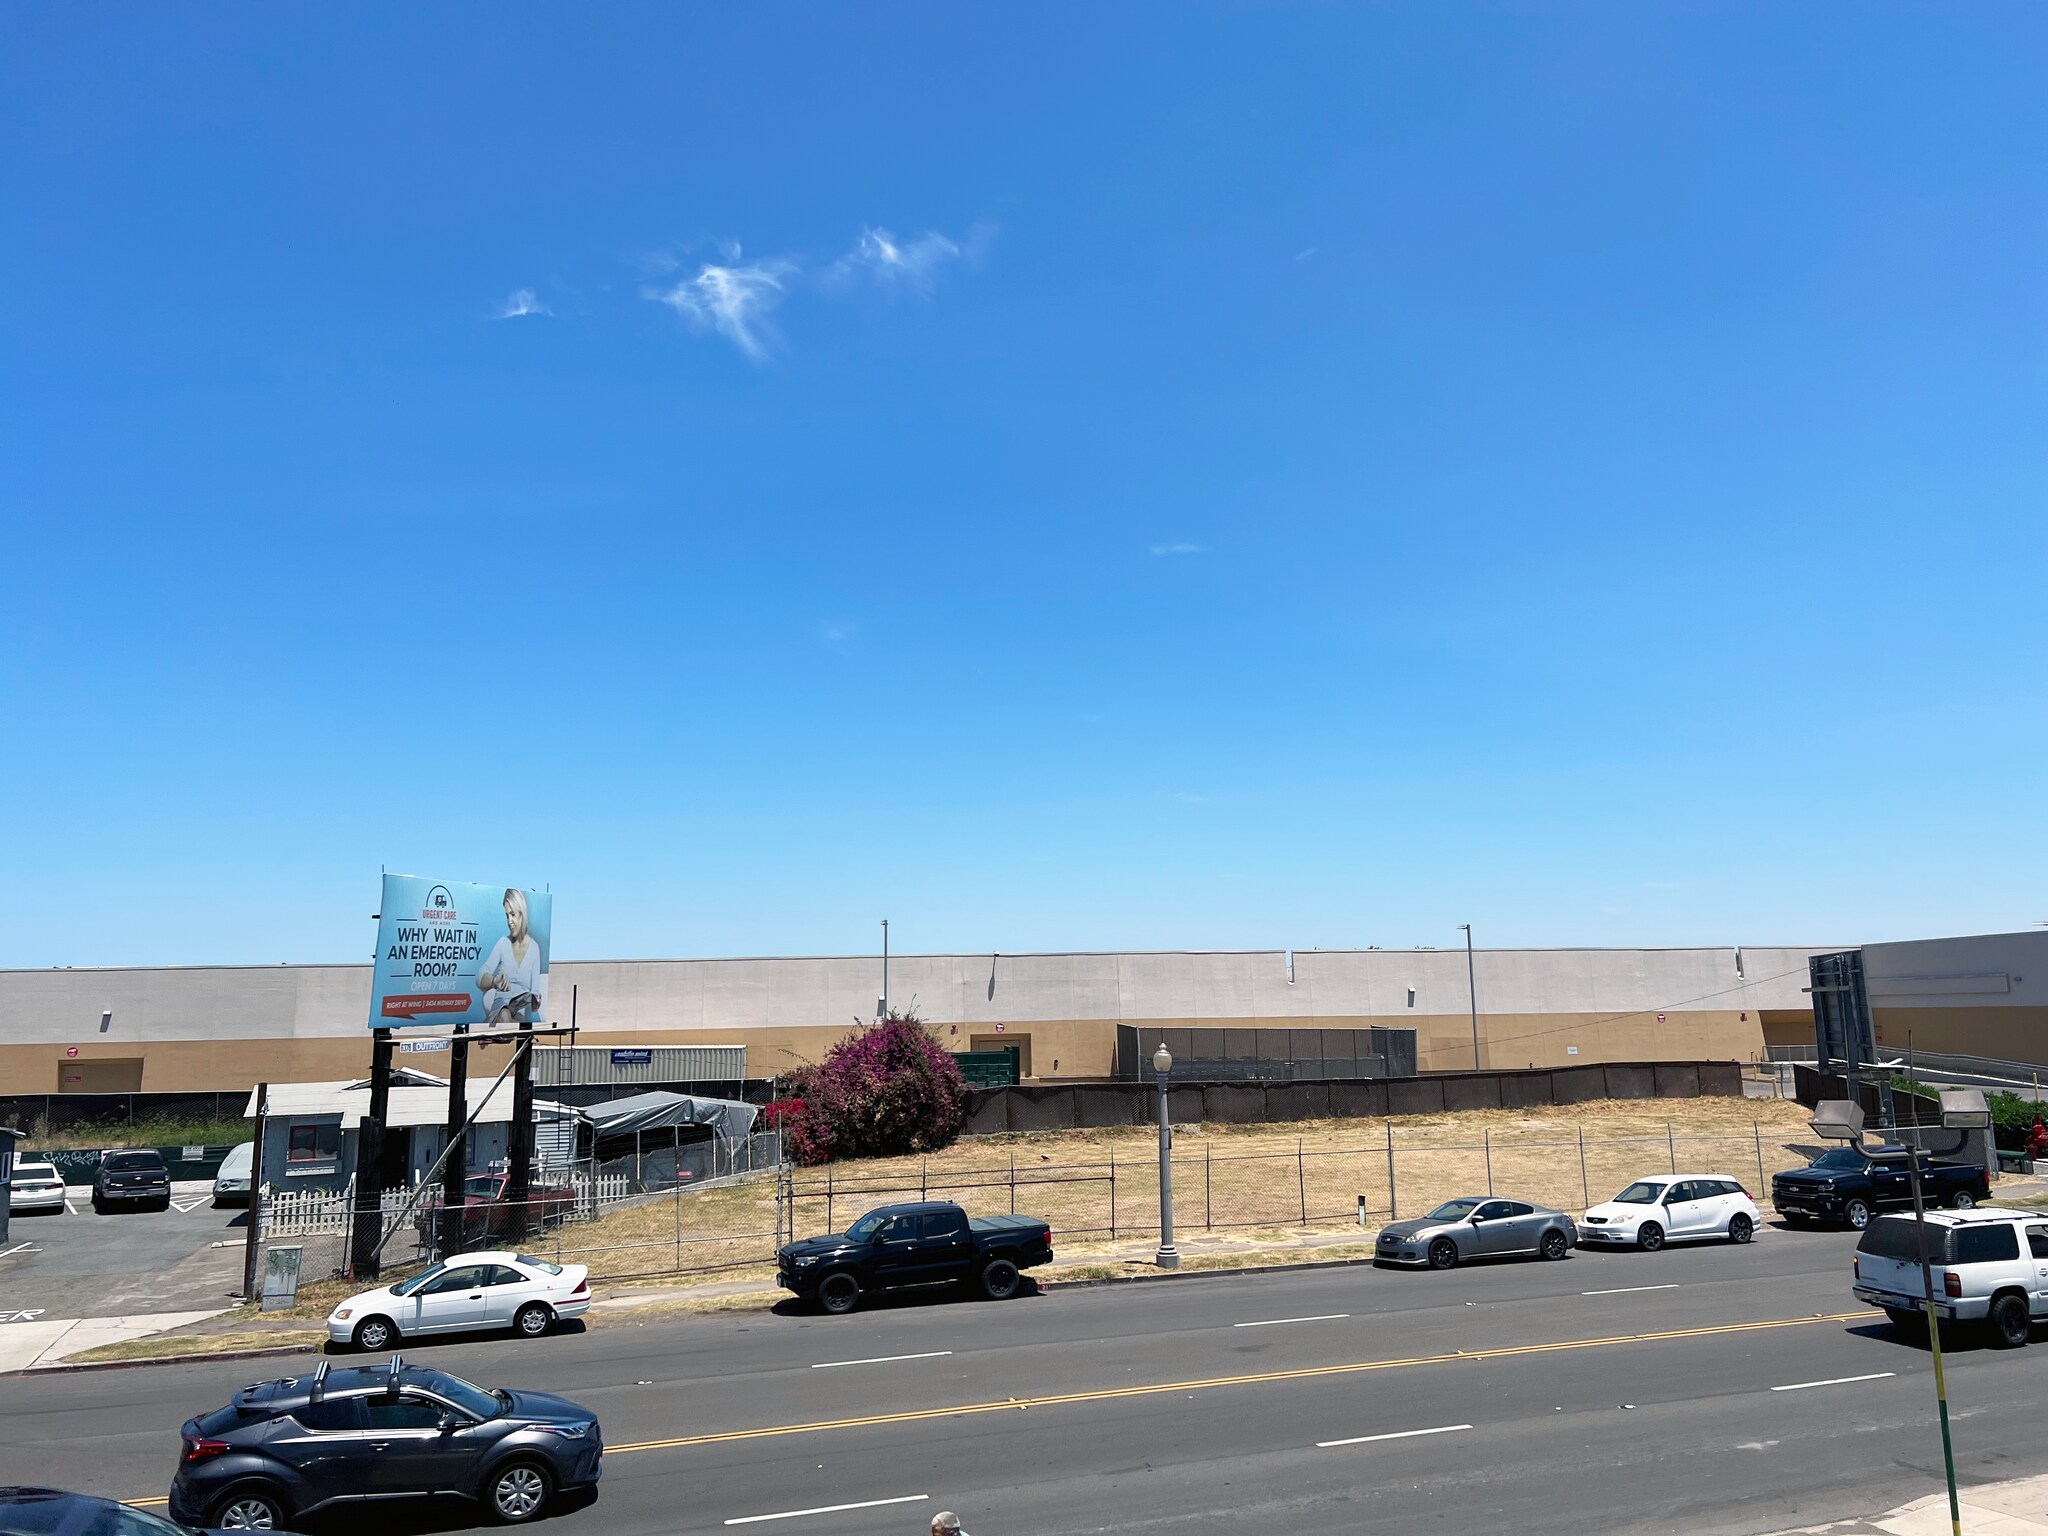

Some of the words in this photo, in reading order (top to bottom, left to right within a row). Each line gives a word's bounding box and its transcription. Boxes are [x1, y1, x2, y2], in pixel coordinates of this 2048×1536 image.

[444, 911, 457, 921] CARE
[398, 928, 428, 942] WHY
[434, 928, 464, 944] WAIT
[466, 930, 476, 944] IN
[387, 946, 408, 960] AN
[411, 946, 482, 960] EMERGENCY
[414, 963, 458, 977] ROOM?
[410, 982, 432, 992] OPEN
[433, 982, 439, 991] 7
[439, 981, 456, 990] DAYS
